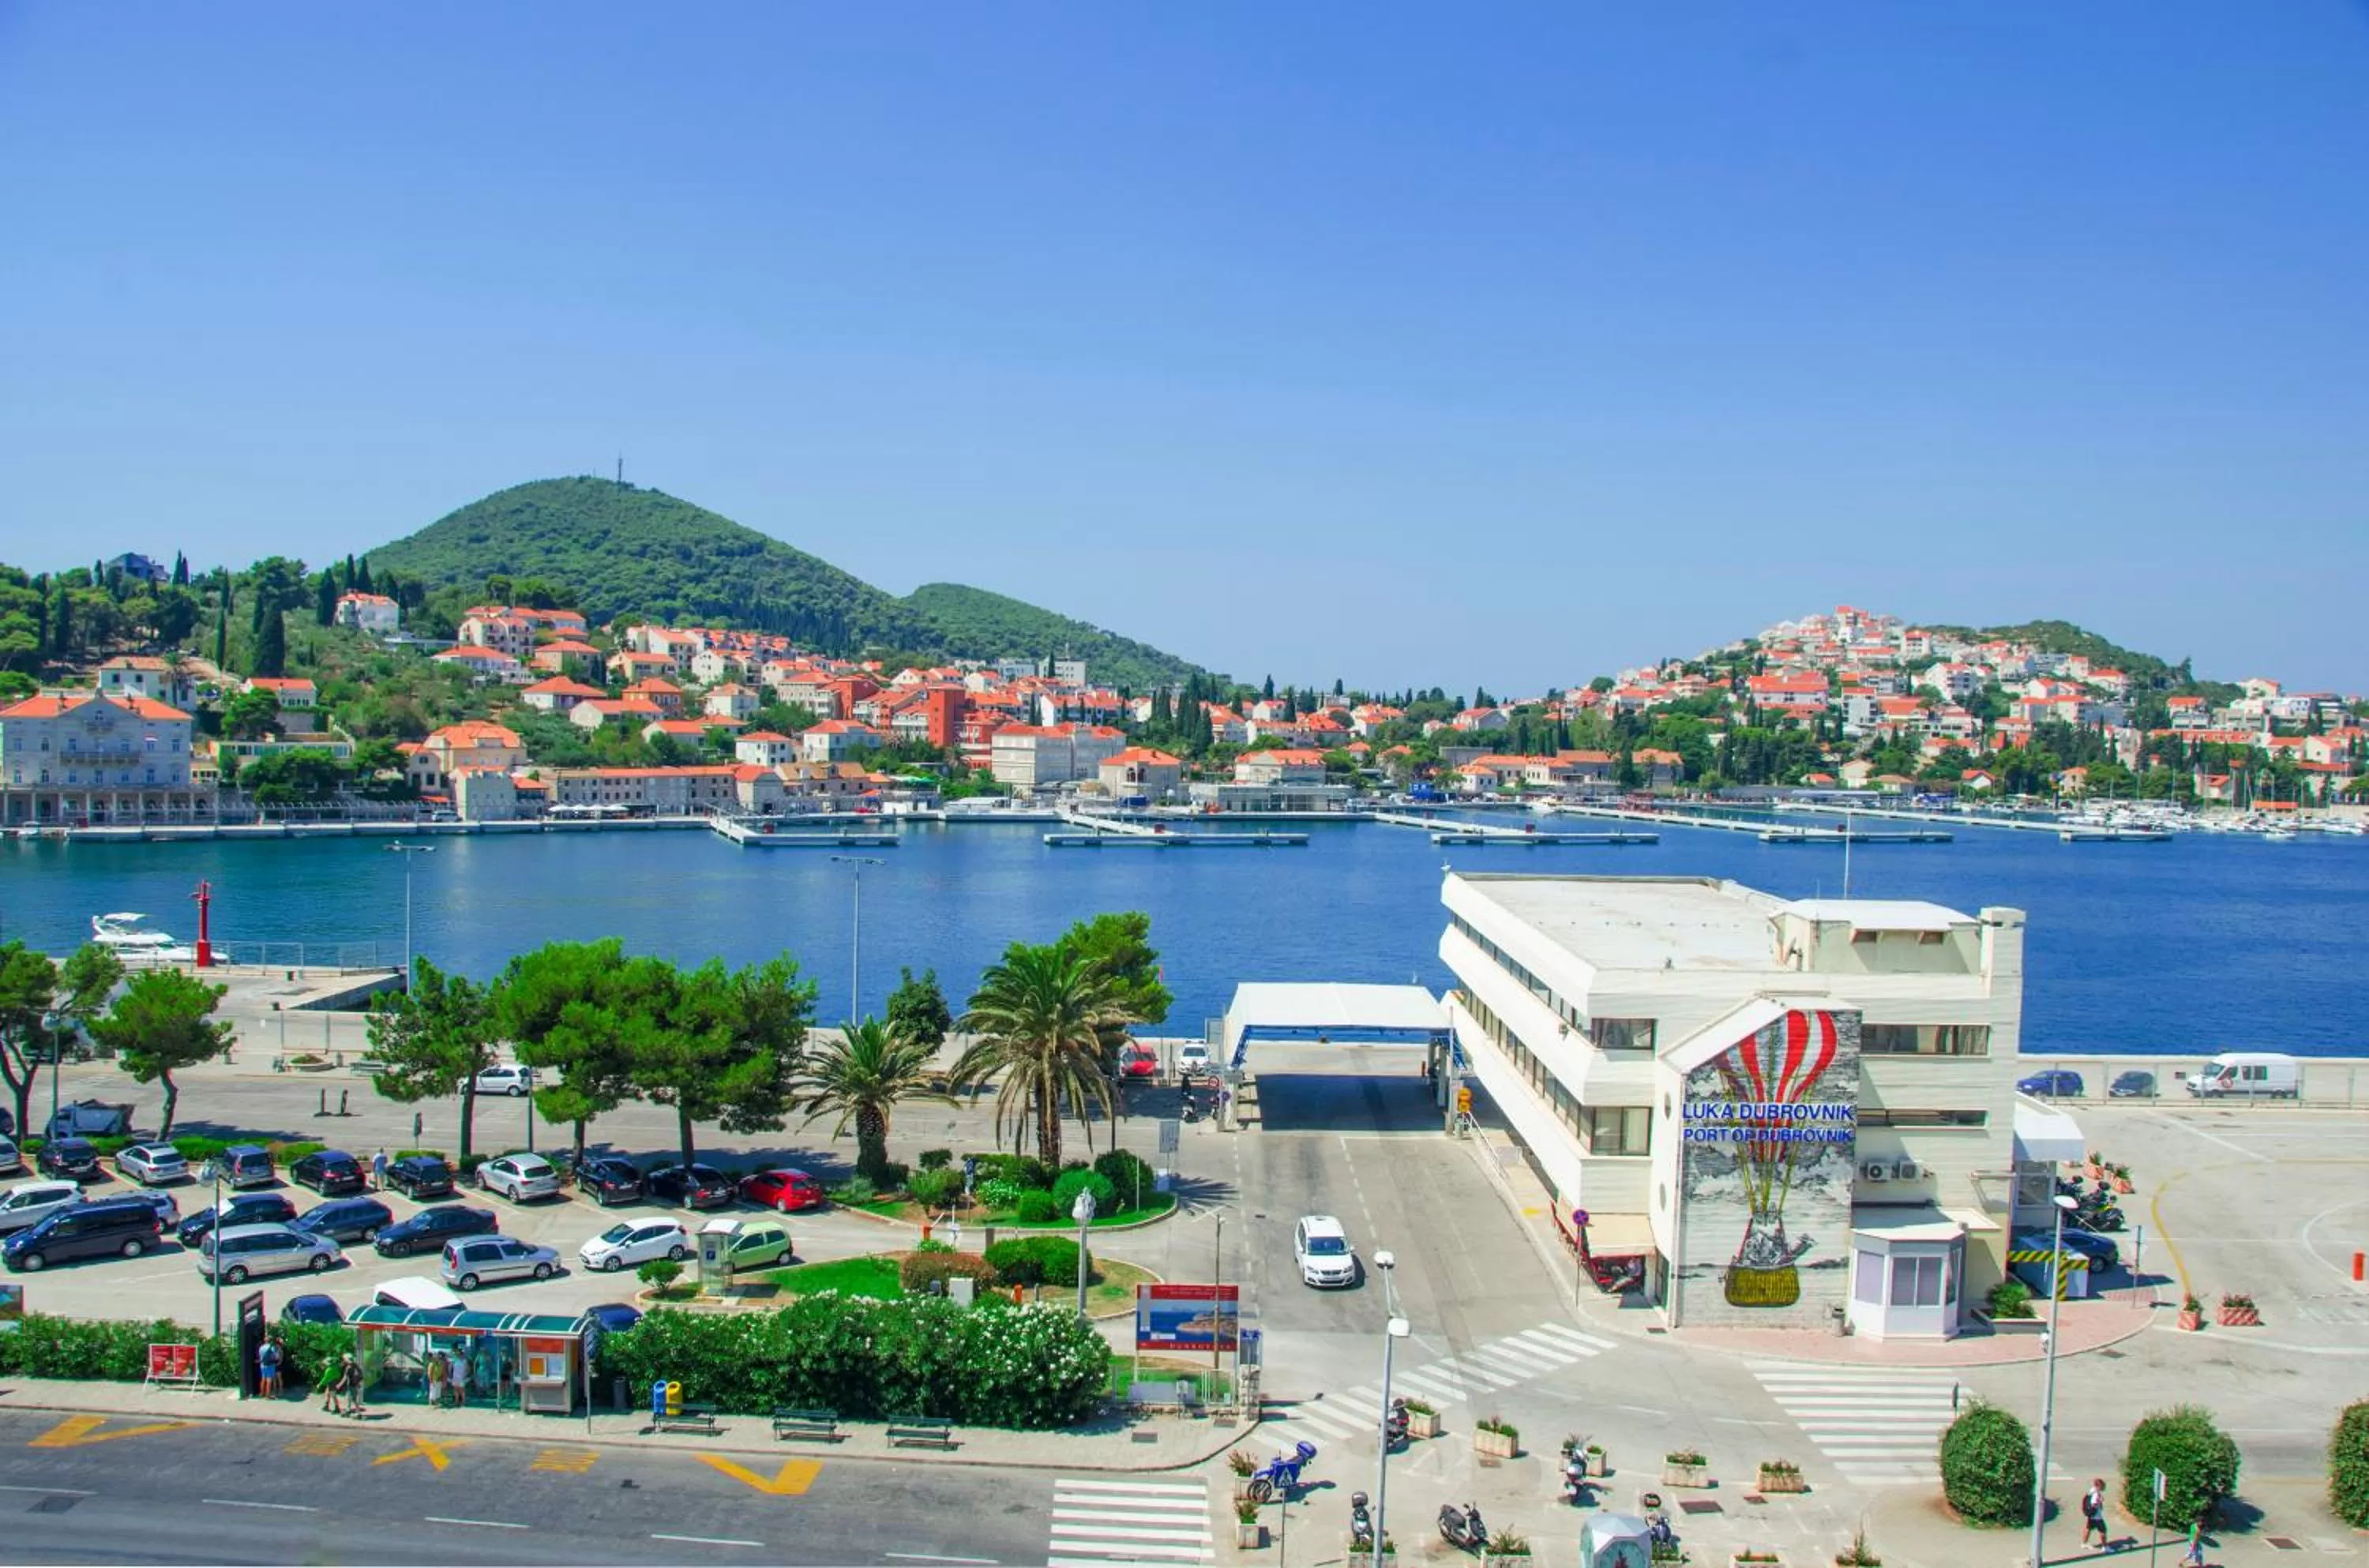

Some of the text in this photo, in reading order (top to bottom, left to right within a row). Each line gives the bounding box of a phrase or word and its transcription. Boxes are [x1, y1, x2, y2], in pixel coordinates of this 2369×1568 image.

[1683, 1103, 1855, 1121] LUKA DUBROVNIK
[1683, 1127, 1855, 1143] PORT OF DUBROVNIK
